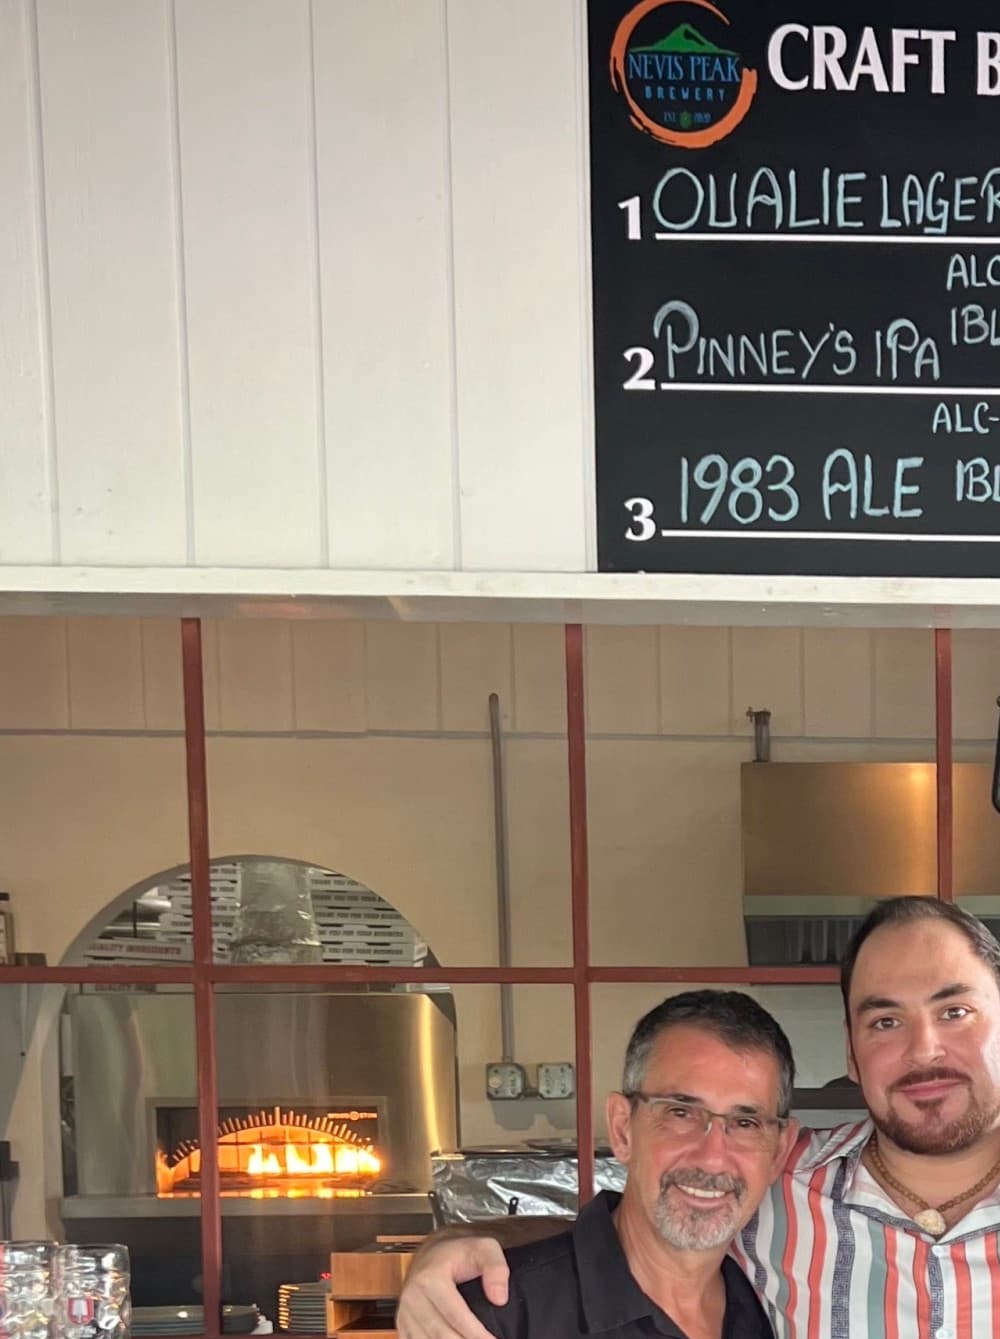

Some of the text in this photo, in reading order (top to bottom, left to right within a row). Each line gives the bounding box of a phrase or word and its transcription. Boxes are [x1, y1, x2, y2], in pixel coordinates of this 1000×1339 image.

[628, 53, 741, 82] NEVIS PEAK
[767, 23, 956, 95] CRAFT
[644, 86, 726, 101] BREWERY
[617, 196, 641, 240] 1
[653, 300, 941, 381] PINNEY'S IPA
[622, 346, 656, 391] 2
[680, 448, 924, 524] 1983 ALE
[623, 498, 656, 541] 3
